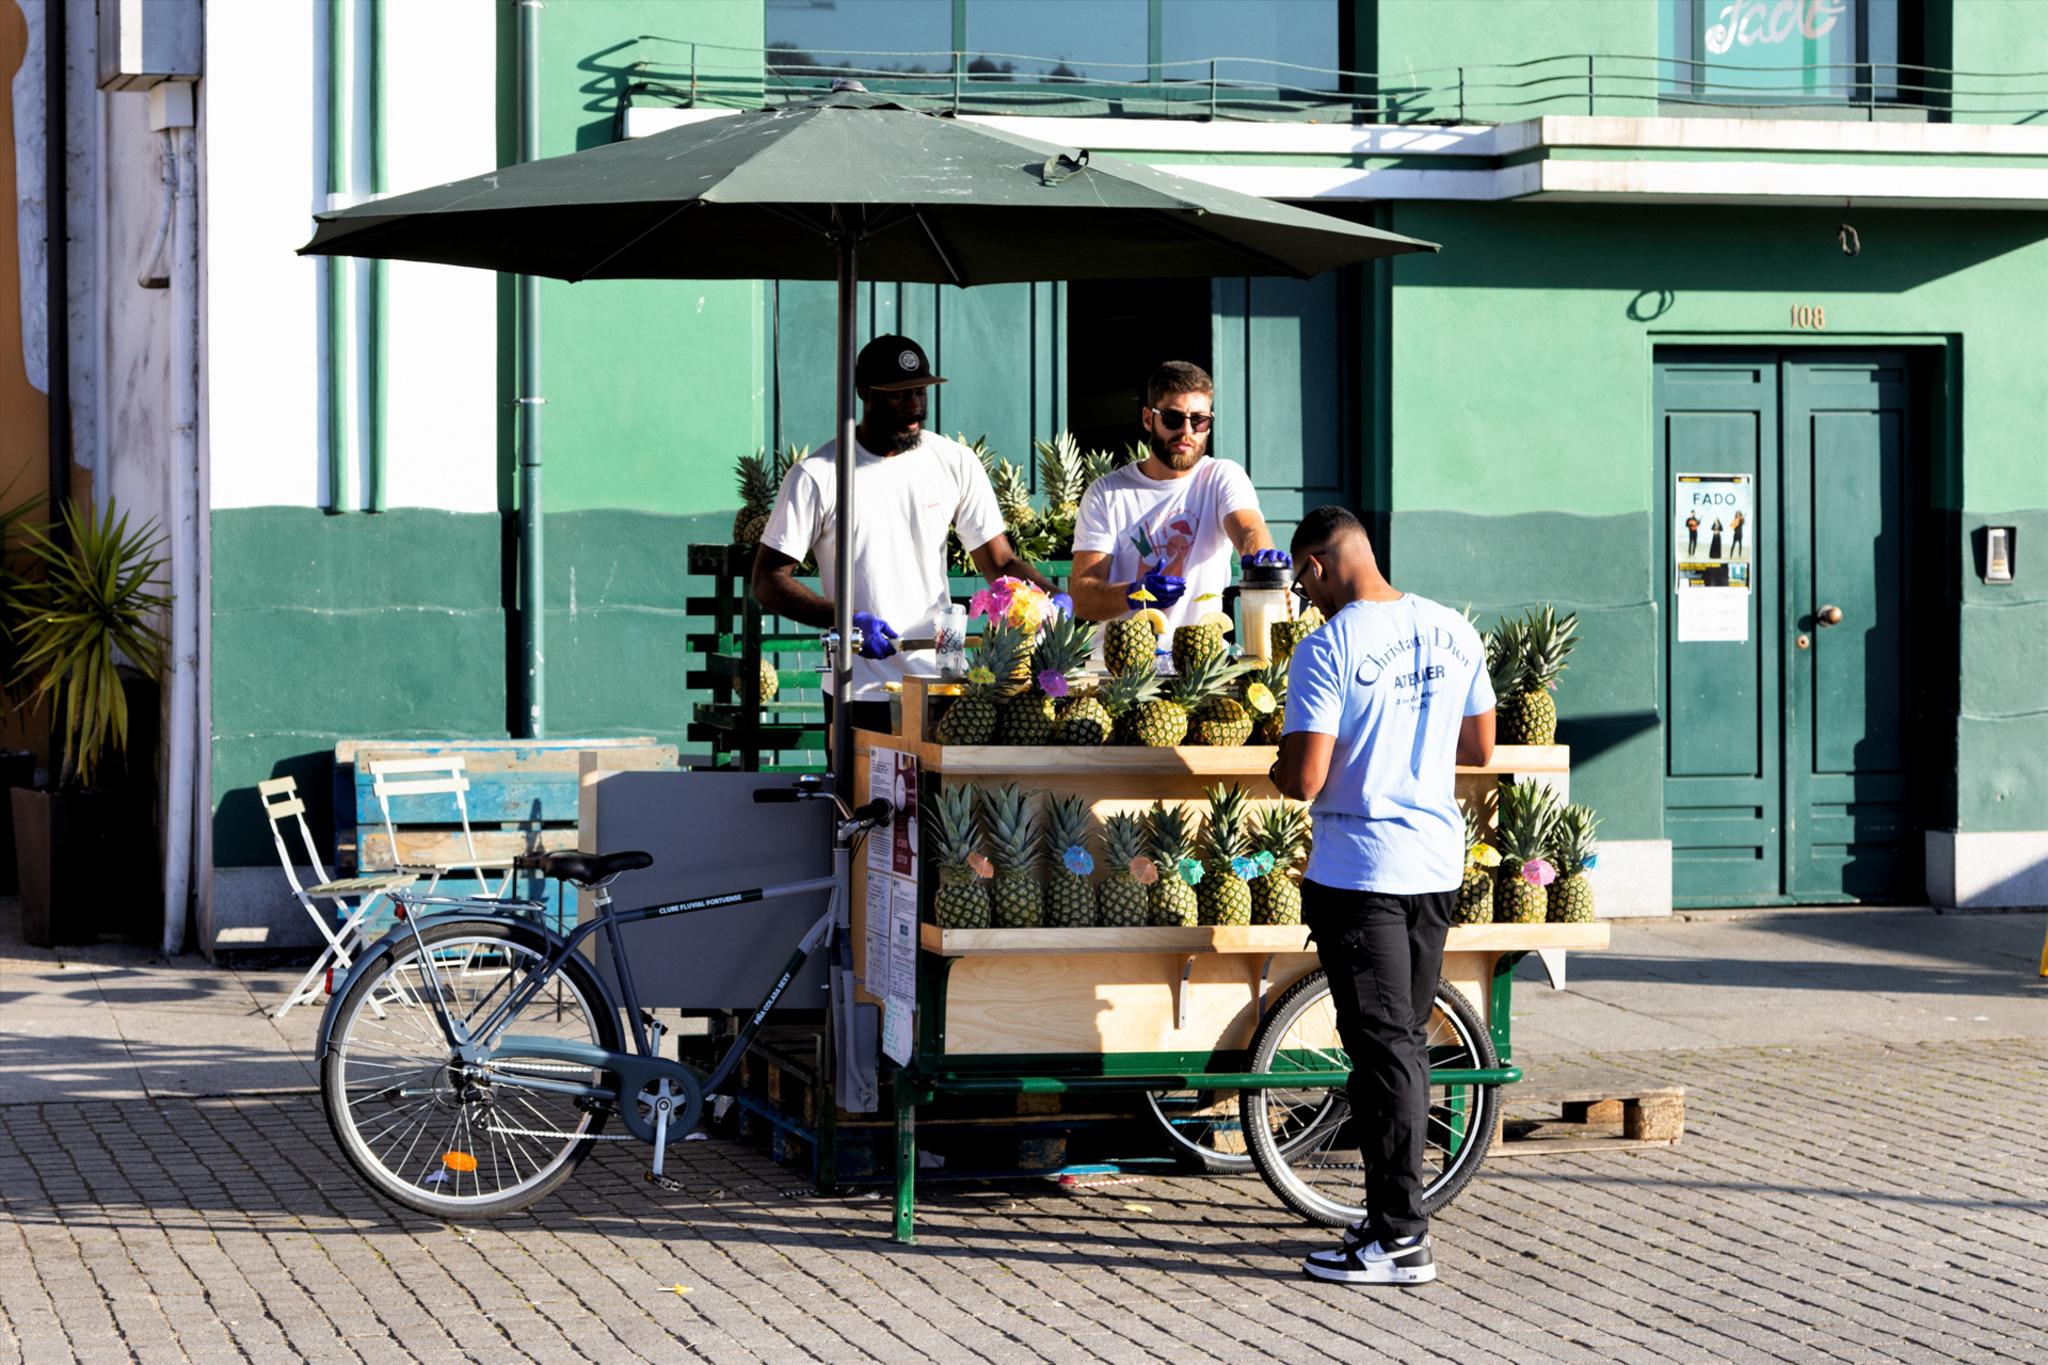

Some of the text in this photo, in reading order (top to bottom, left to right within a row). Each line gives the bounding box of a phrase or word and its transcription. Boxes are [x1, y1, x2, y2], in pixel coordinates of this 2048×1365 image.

[1791, 304, 1825, 330] 108
[1693, 492, 1737, 506] FADO
[1355, 626, 1471, 686] Christan Dior
[1395, 665, 1445, 689] ATELIER
[659, 894, 742, 914] CLUBE FLUVIAL PORTUENSE
[763, 988, 780, 1011] COLADA
[778, 972, 791, 989] SEXY
